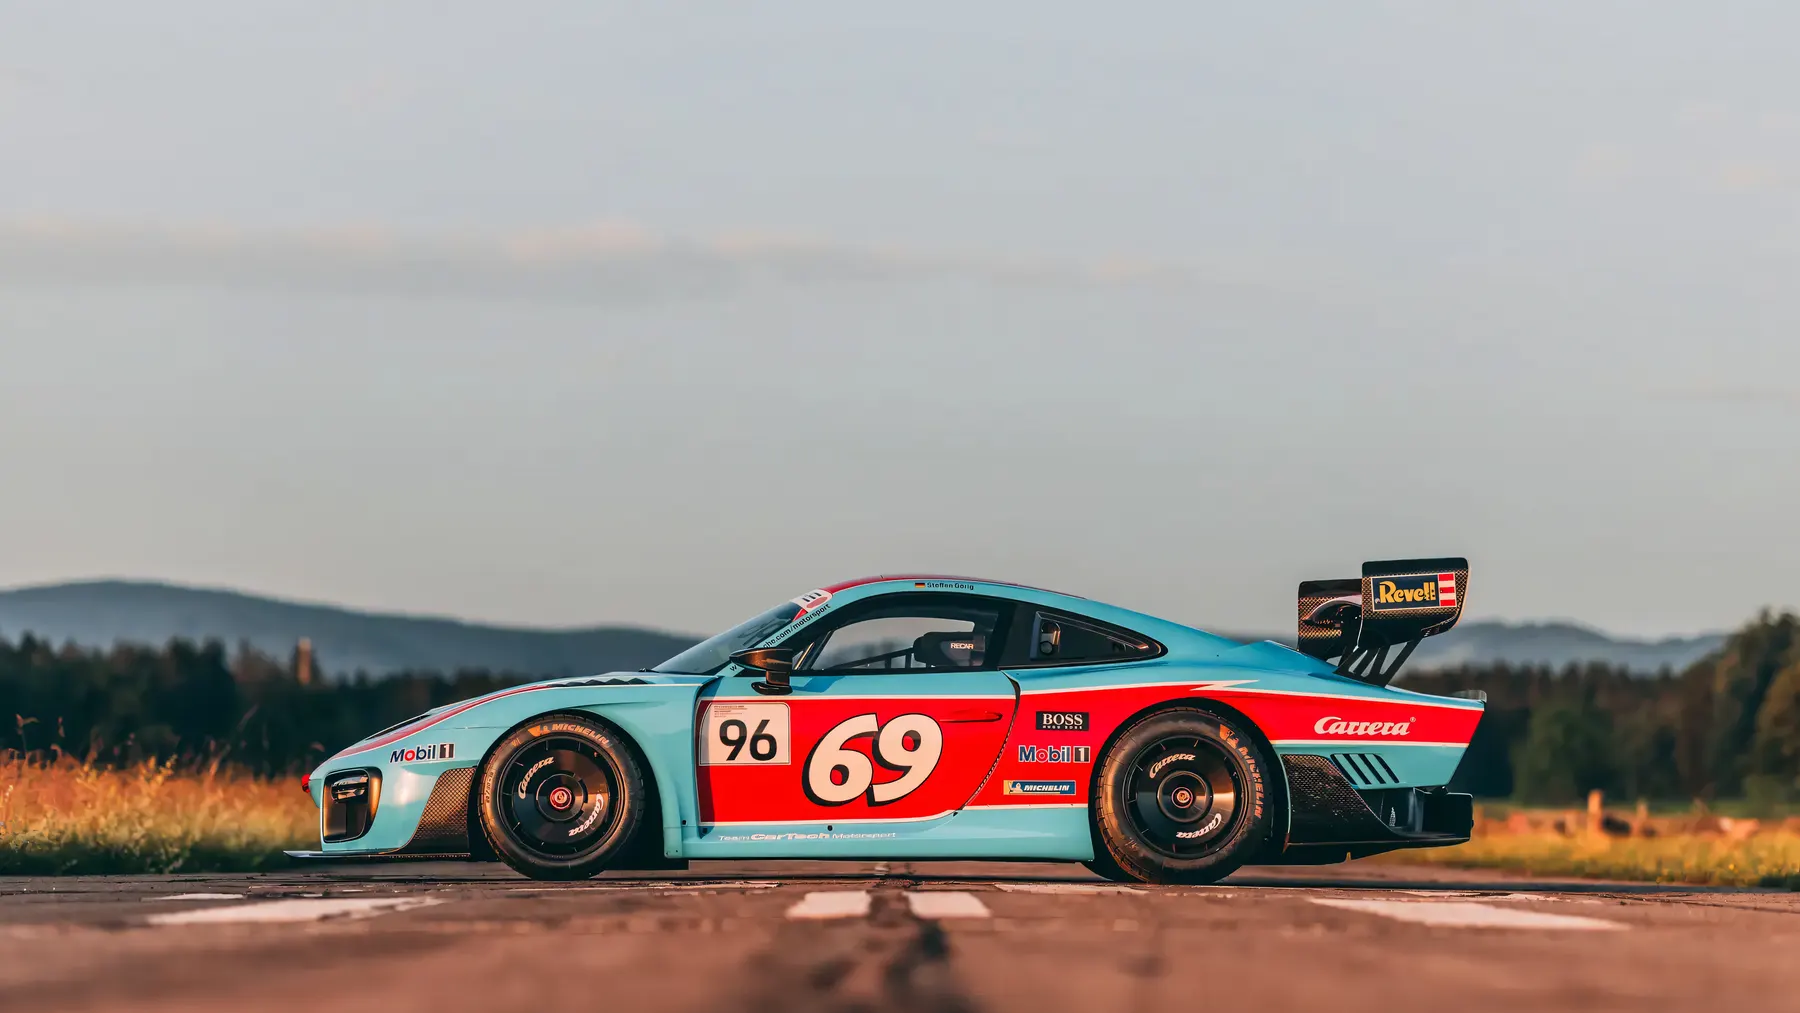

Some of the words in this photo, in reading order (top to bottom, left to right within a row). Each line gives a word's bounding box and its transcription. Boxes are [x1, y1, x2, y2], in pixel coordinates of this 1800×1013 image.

[1379, 581, 1436, 604] Revell
[950, 642, 974, 650] RECAR
[1042, 713, 1083, 726] BOSS
[551, 723, 610, 747] MICHELIN
[719, 719, 777, 761] 96
[389, 744, 437, 763] Mobil
[801, 712, 944, 808] 69
[1018, 745, 1071, 763] Mobil
[1149, 753, 1196, 779] Carrera
[518, 756, 555, 799] Carrera
[1238, 746, 1264, 819] MICHELIN
[568, 793, 604, 837] Carrera
[1176, 813, 1222, 839] Carrera
[750, 833, 830, 841] CarTech
[832, 832, 896, 840] Motorsport
